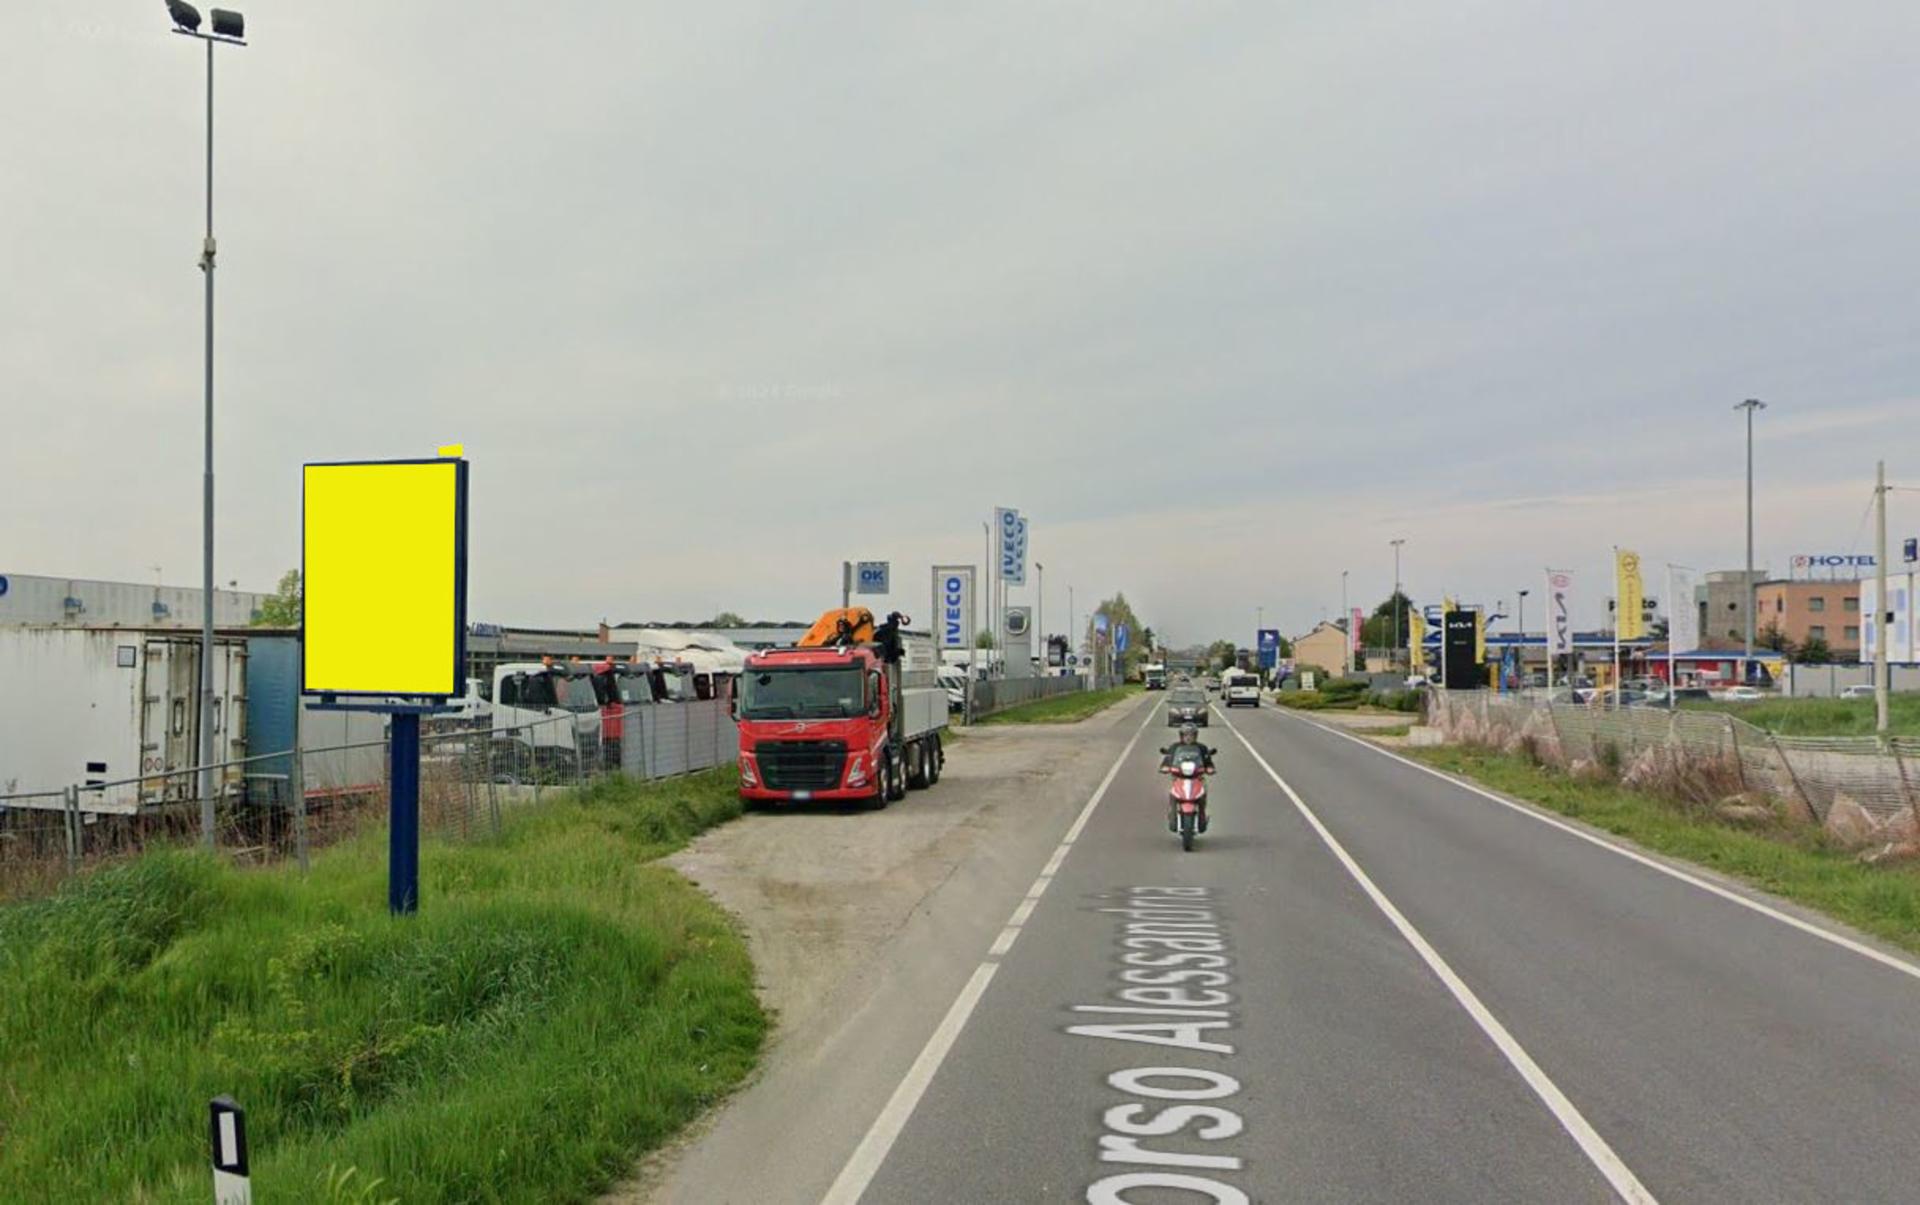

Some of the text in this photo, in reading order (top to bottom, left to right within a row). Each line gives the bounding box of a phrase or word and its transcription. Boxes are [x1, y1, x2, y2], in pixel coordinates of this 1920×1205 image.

[1003, 512, 1015, 575] IVECO
[1810, 556, 1877, 566] HOTEL
[861, 570, 884, 581] OK
[946, 578, 960, 644] IVECO
